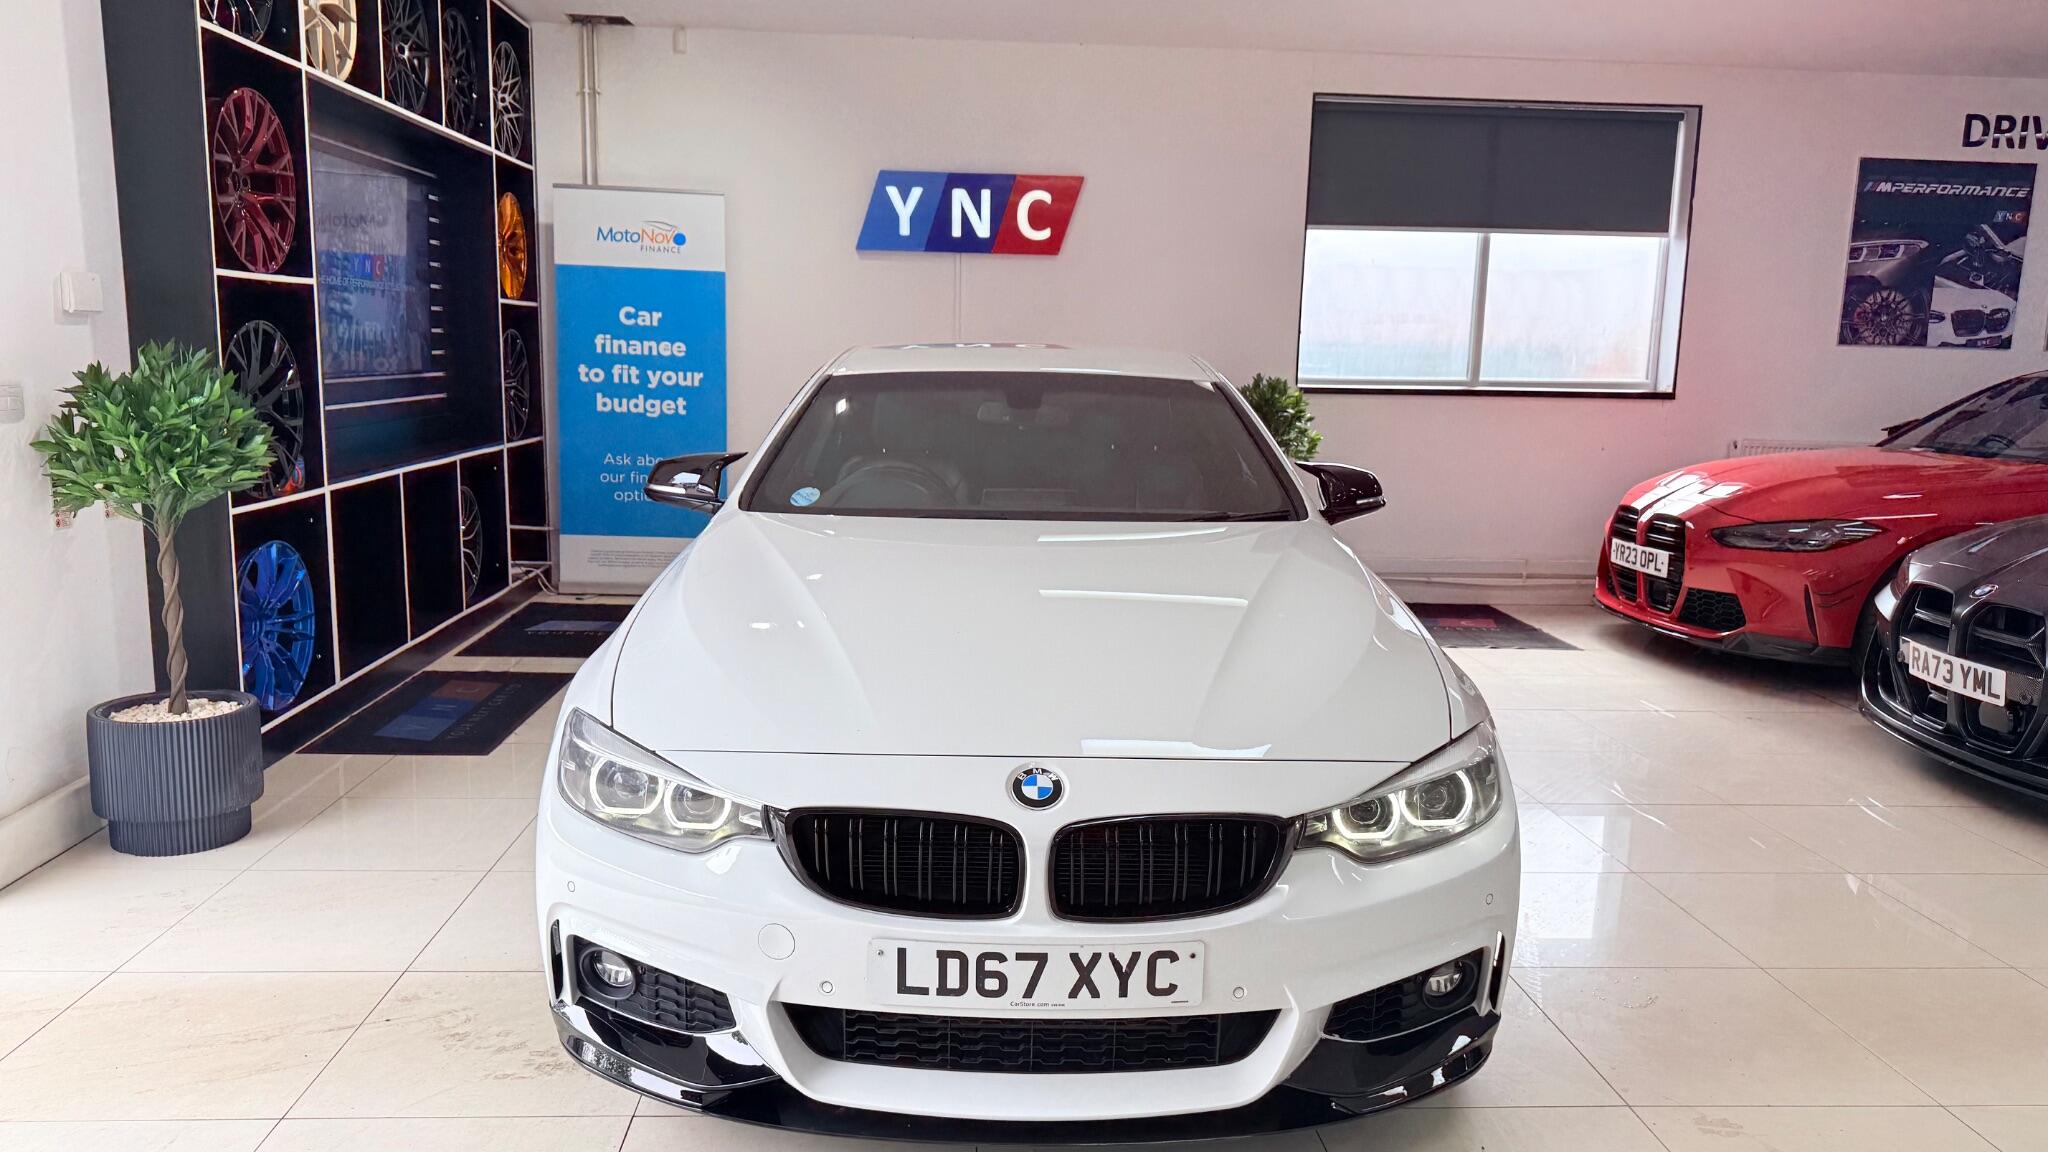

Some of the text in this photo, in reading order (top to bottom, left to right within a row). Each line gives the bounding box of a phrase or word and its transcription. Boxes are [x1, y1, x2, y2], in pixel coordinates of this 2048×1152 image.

[885, 185, 1052, 241] YNC
[640, 245, 682, 254] FINANCE
[618, 306, 662, 327] Car
[594, 334, 687, 357] finance
[578, 364, 704, 388] to fit your
[596, 392, 687, 417] budget
[603, 453, 632, 465] Ask
[600, 472, 625, 483] our
[1615, 542, 1662, 572] YR23 OPL
[1912, 644, 2001, 699] RA73 YML
[1018, 768, 1059, 781] BMW
[896, 947, 1180, 998] LD67 XYC
